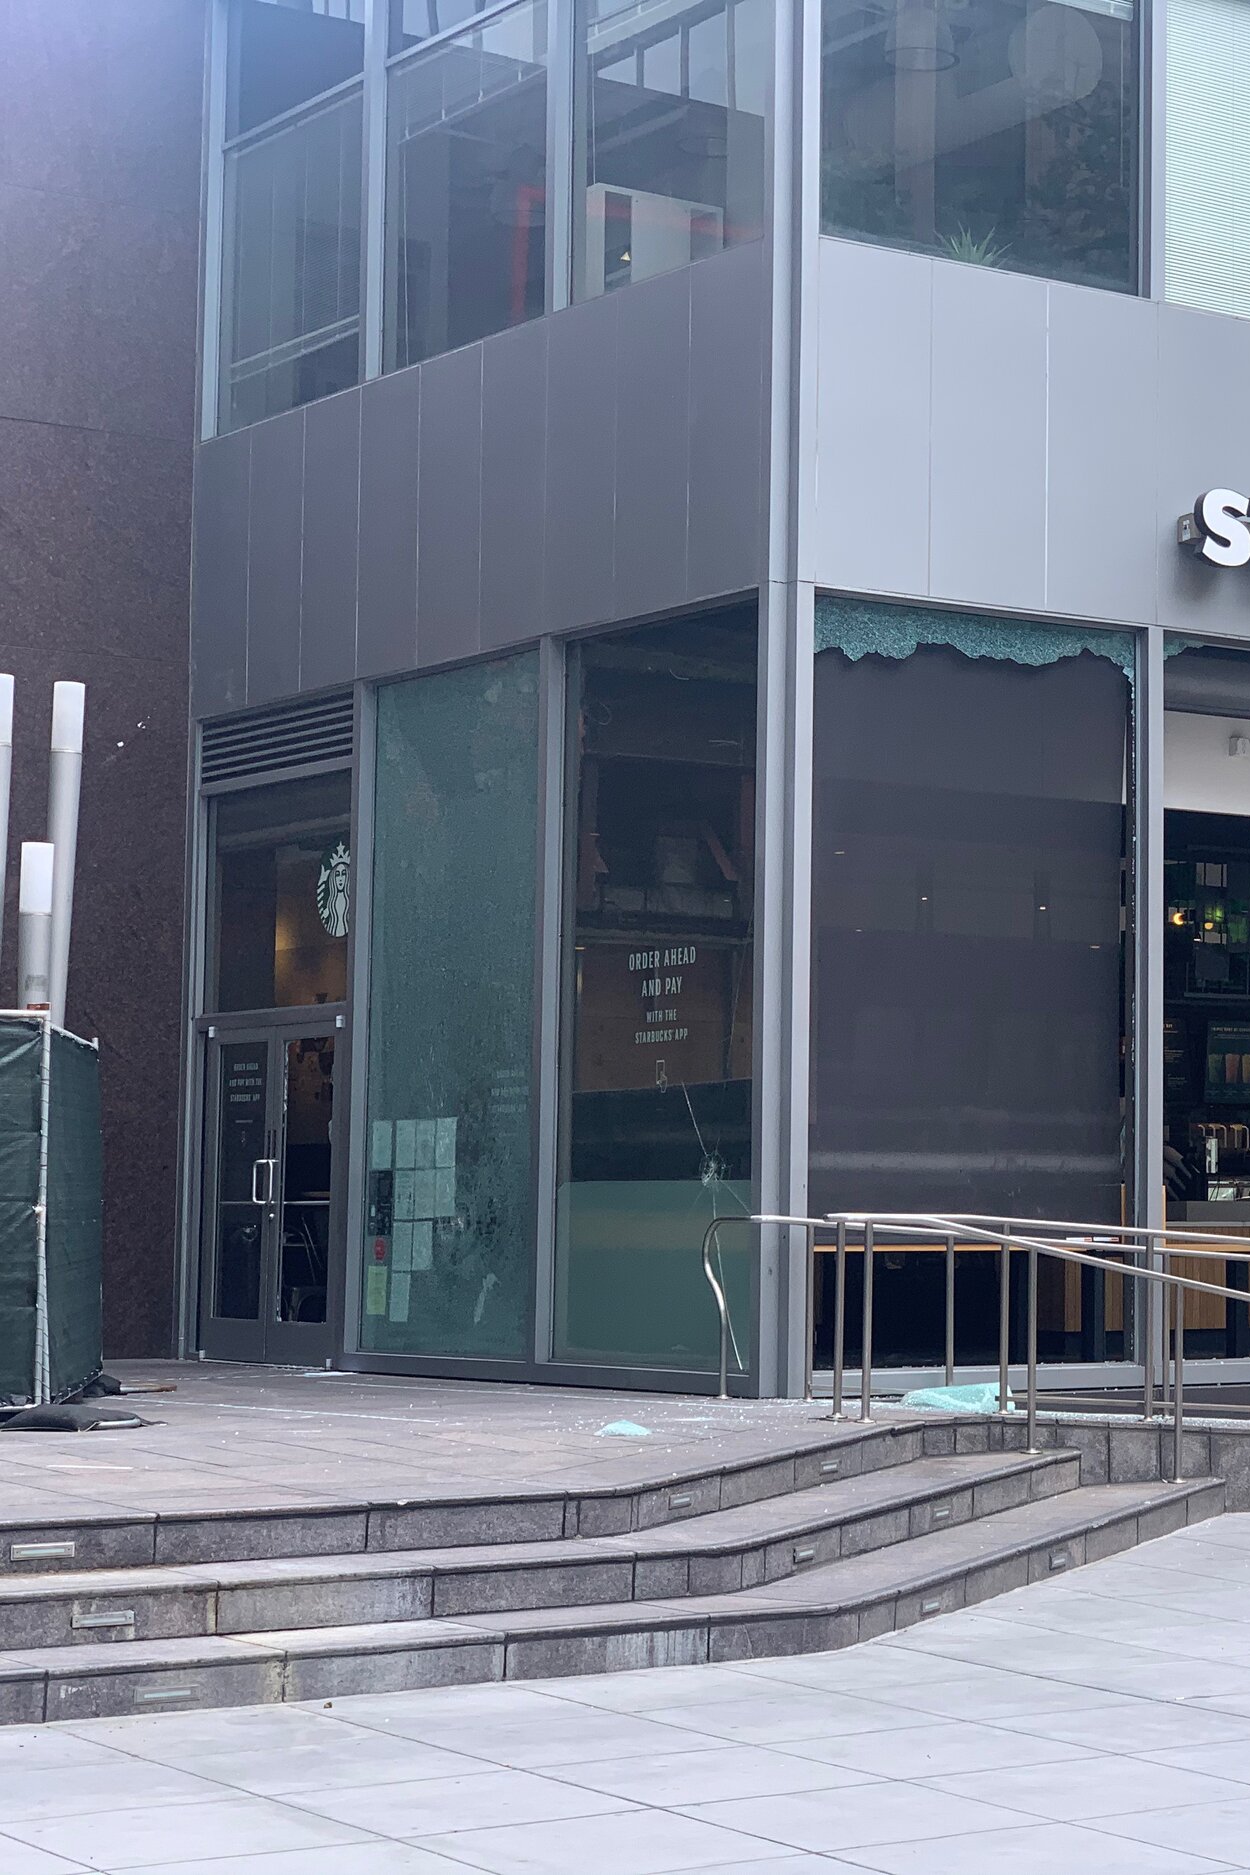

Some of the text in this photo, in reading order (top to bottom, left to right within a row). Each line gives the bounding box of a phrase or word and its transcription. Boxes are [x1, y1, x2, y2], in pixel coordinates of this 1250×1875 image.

[628, 946, 696, 971] ORDER AHEAD
[641, 976, 683, 997] AND PAY
[646, 1009, 678, 1023] WITH THE
[674, 1028, 688, 1040] APP
